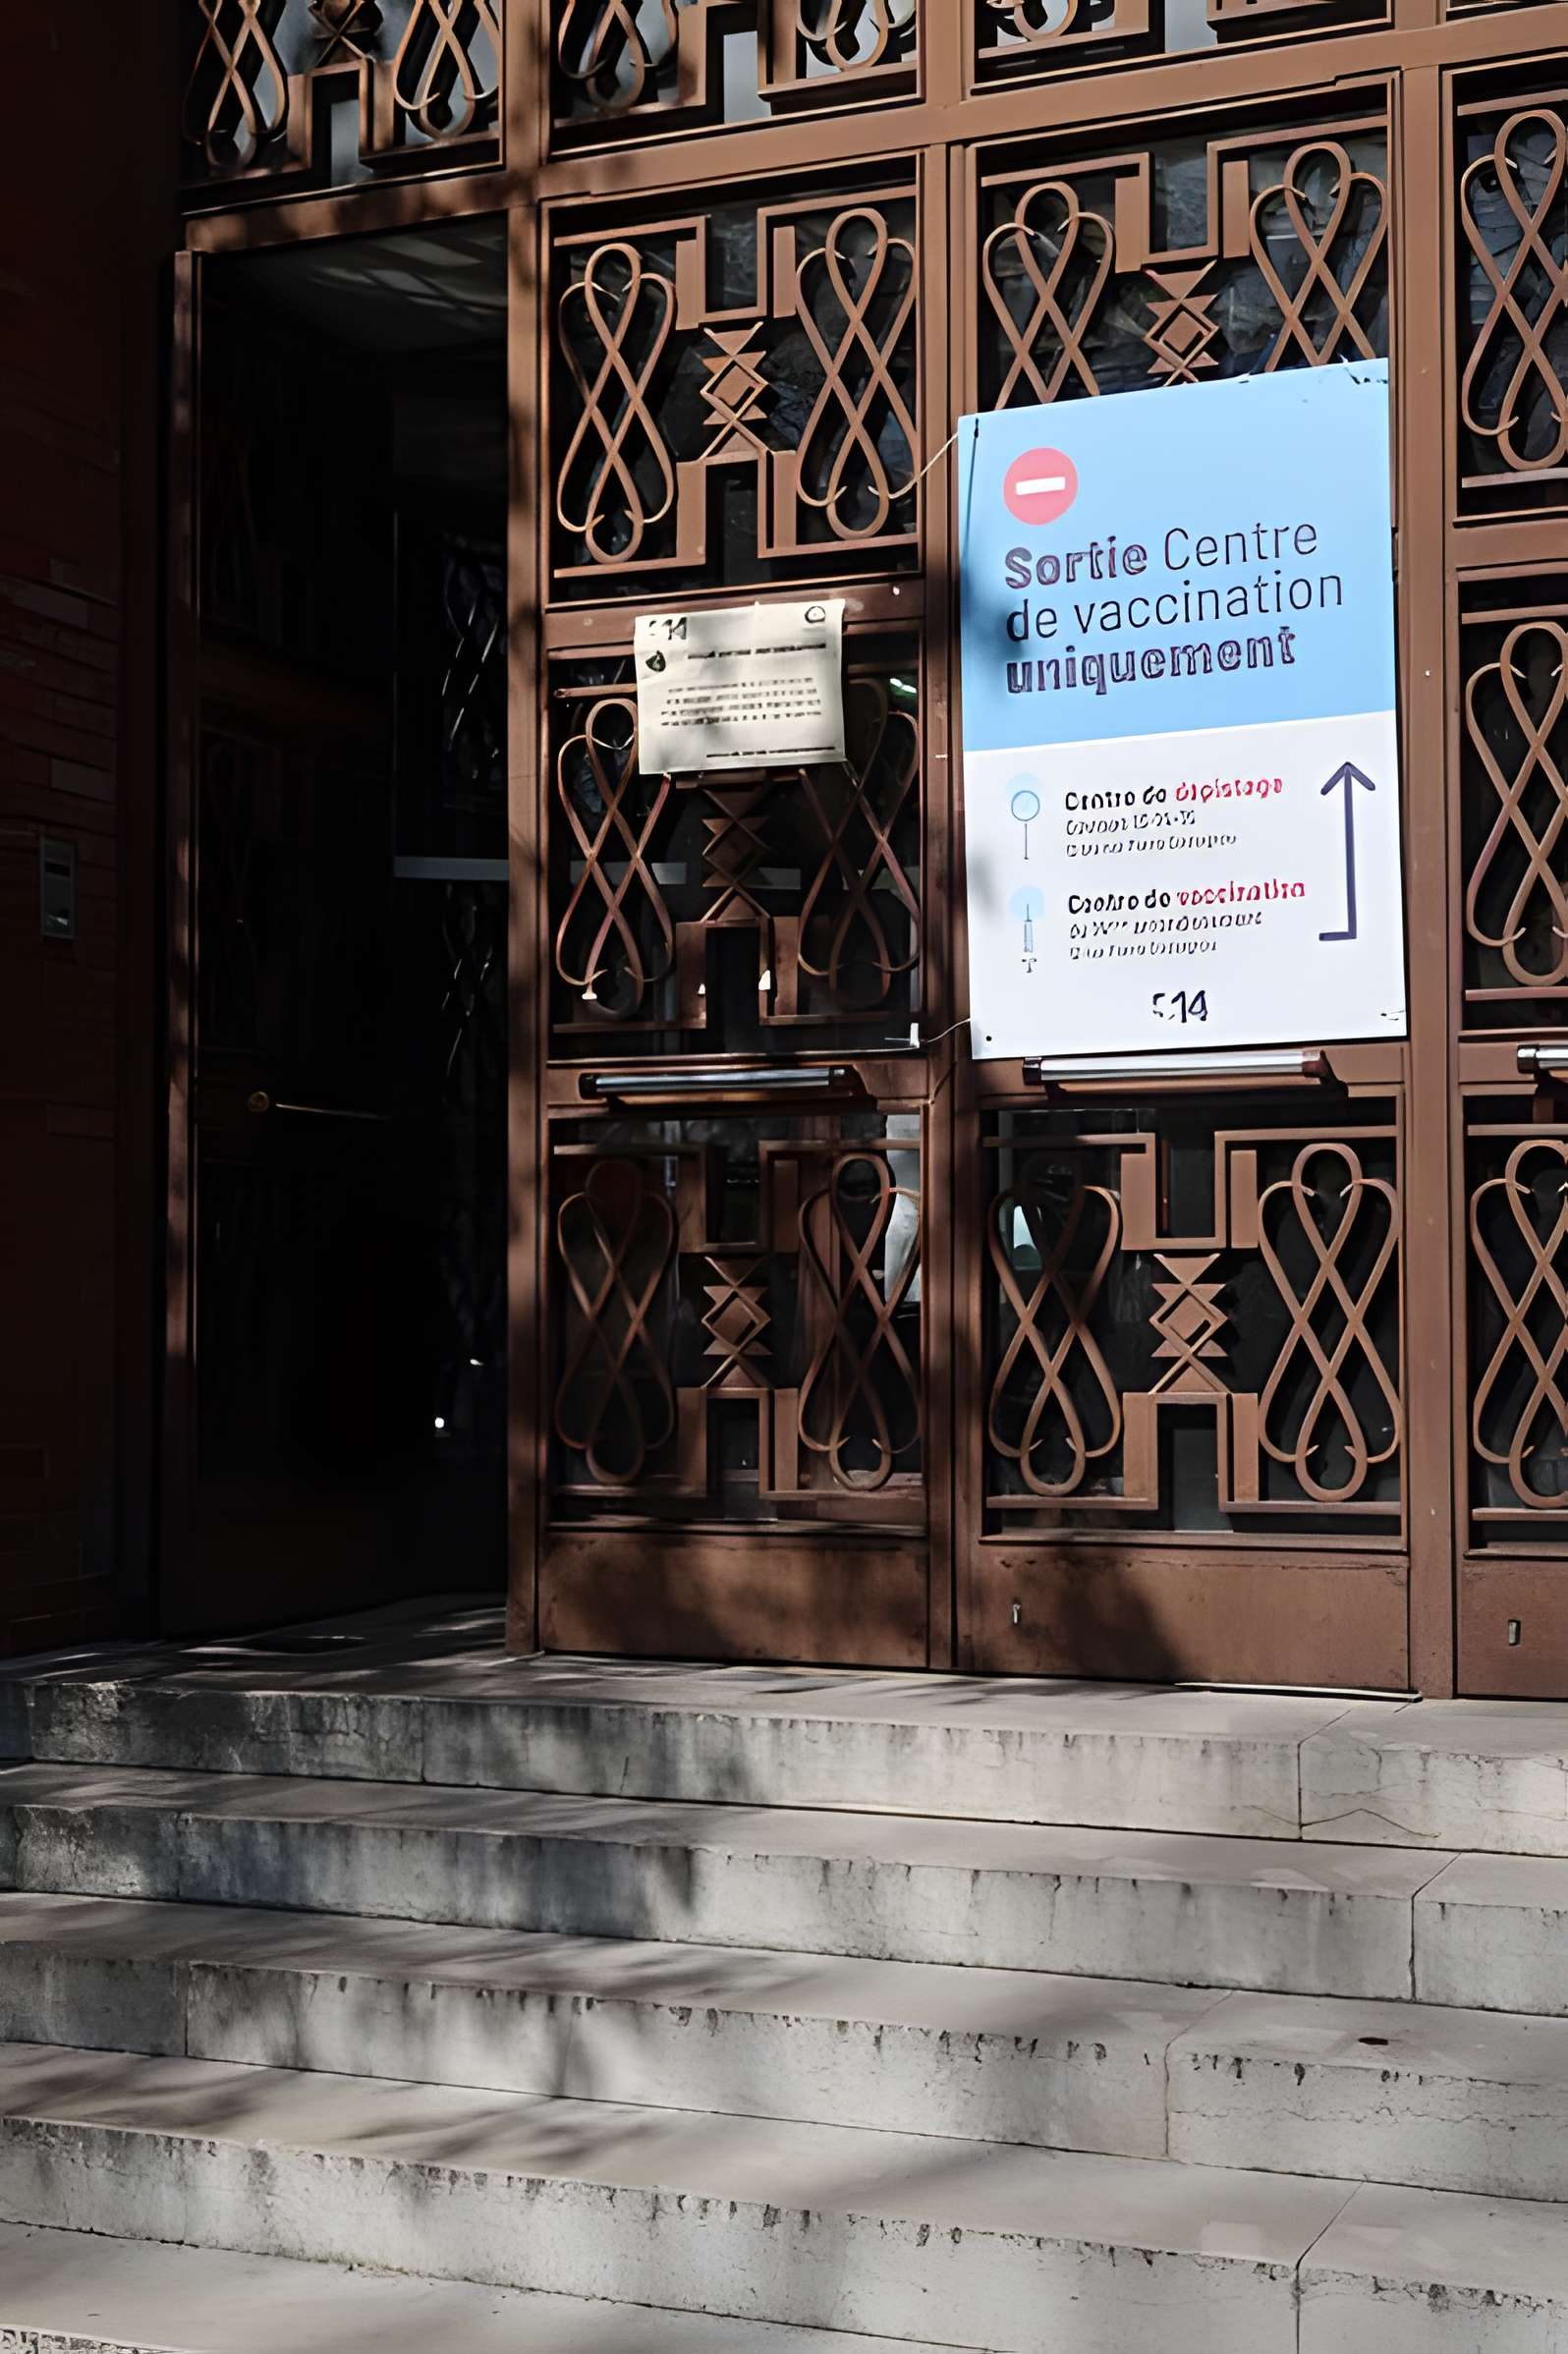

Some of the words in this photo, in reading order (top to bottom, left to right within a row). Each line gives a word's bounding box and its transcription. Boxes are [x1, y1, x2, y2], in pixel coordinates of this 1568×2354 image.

[1005, 535, 1148, 589] Sortie
[1164, 522, 1317, 571] Centre
[1006, 598, 1058, 643] de
[1074, 570, 1342, 636] vaccination
[1006, 625, 1296, 696] uniquement
